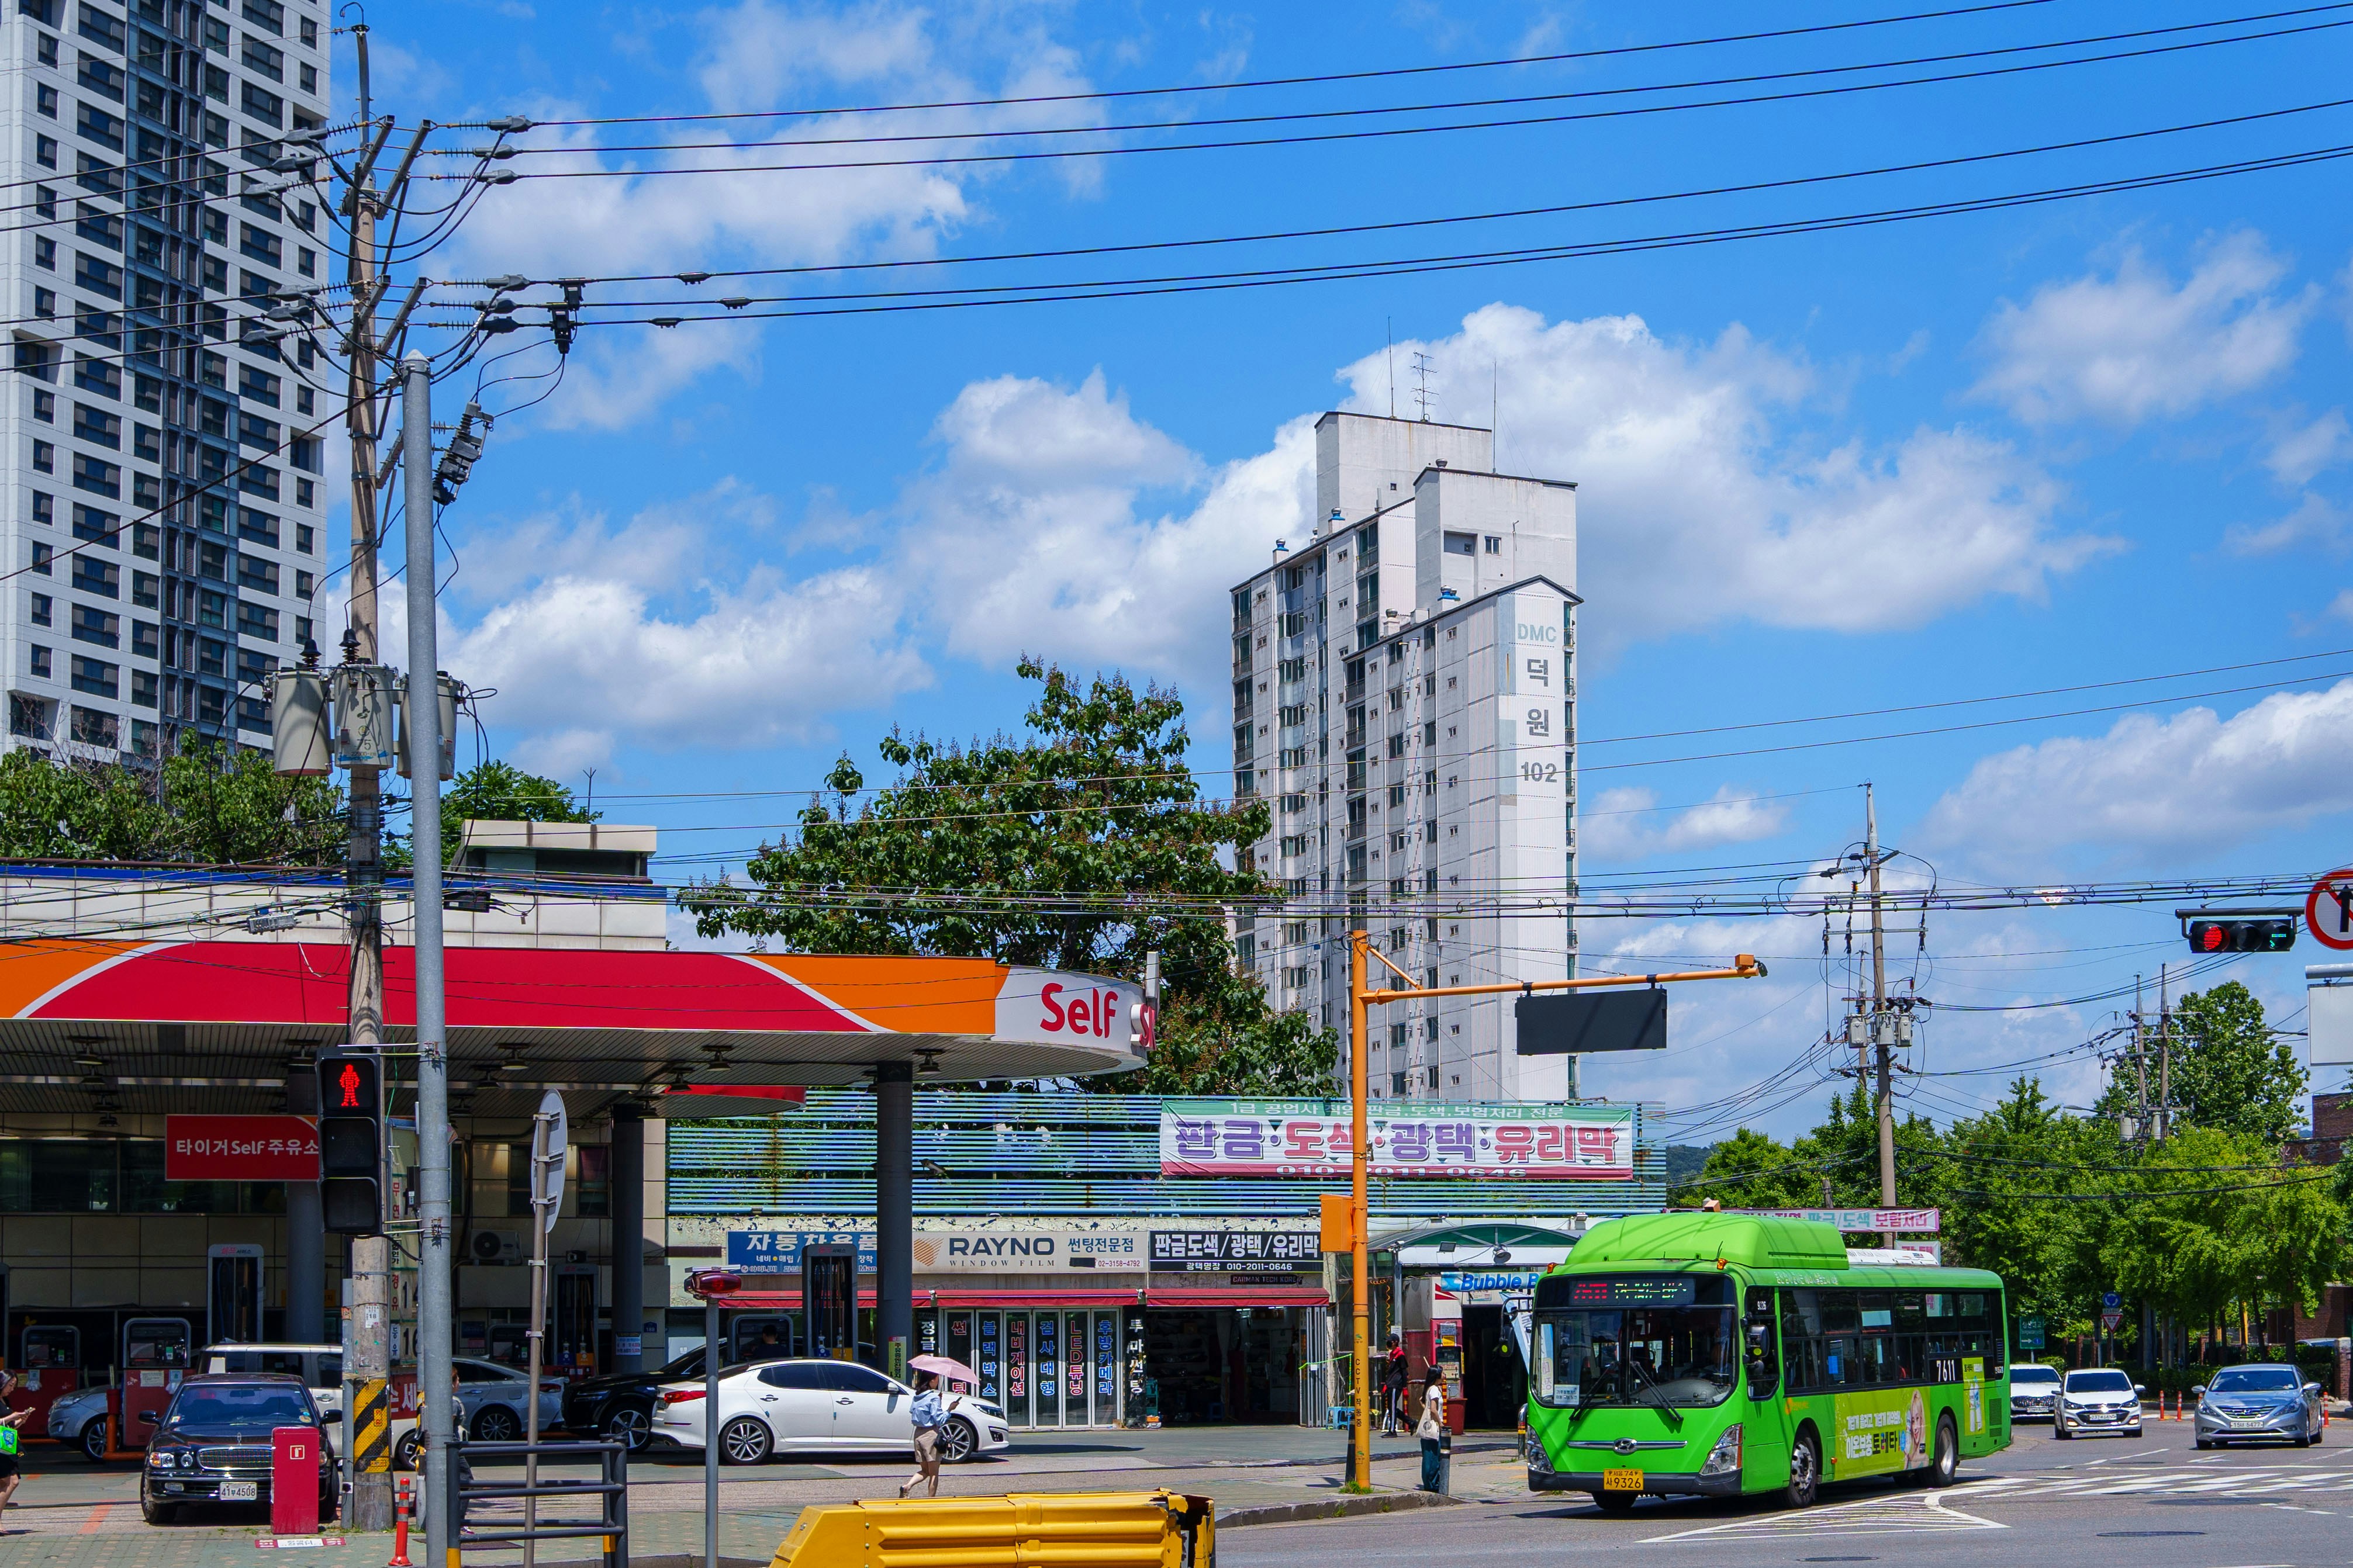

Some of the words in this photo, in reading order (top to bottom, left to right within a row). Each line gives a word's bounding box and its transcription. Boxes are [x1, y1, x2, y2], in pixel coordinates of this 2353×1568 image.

[1517, 623, 1557, 643] DMC
[1526, 658, 1549, 738] 덕원
[1520, 761, 1558, 783] 102
[1040, 982, 1119, 1039] Self
[1230, 1102, 1256, 1114] 1급
[1264, 1102, 1318, 1115] 공업사
[1530, 1106, 1564, 1119] 전문
[1276, 1165, 1527, 1179] 010-011-0646
[1875, 1212, 1927, 1227] 보험처리
[949, 1237, 1055, 1256] RAYNO
[1067, 1237, 1134, 1253] 썬팅전문점
[858, 1255, 873, 1264] 장착
[1097, 1259, 1141, 1268] 02-3158-4792
[1186, 1262, 1221, 1271] 광택명장
[1226, 1262, 1293, 1271] 010-2011-0646
[1461, 1273, 1522, 1290] Bubble
[1528, 1273, 1539, 1289] B
[920, 1320, 935, 1356] 정글
[982, 1320, 997, 1396] 블랙박스
[1010, 1320, 1025, 1396] 내비게이션
[1039, 1320, 1055, 1396] 검사대행
[1097, 1320, 1113, 1396] 후방카메라
[1936, 1360, 1955, 1382] 7611
